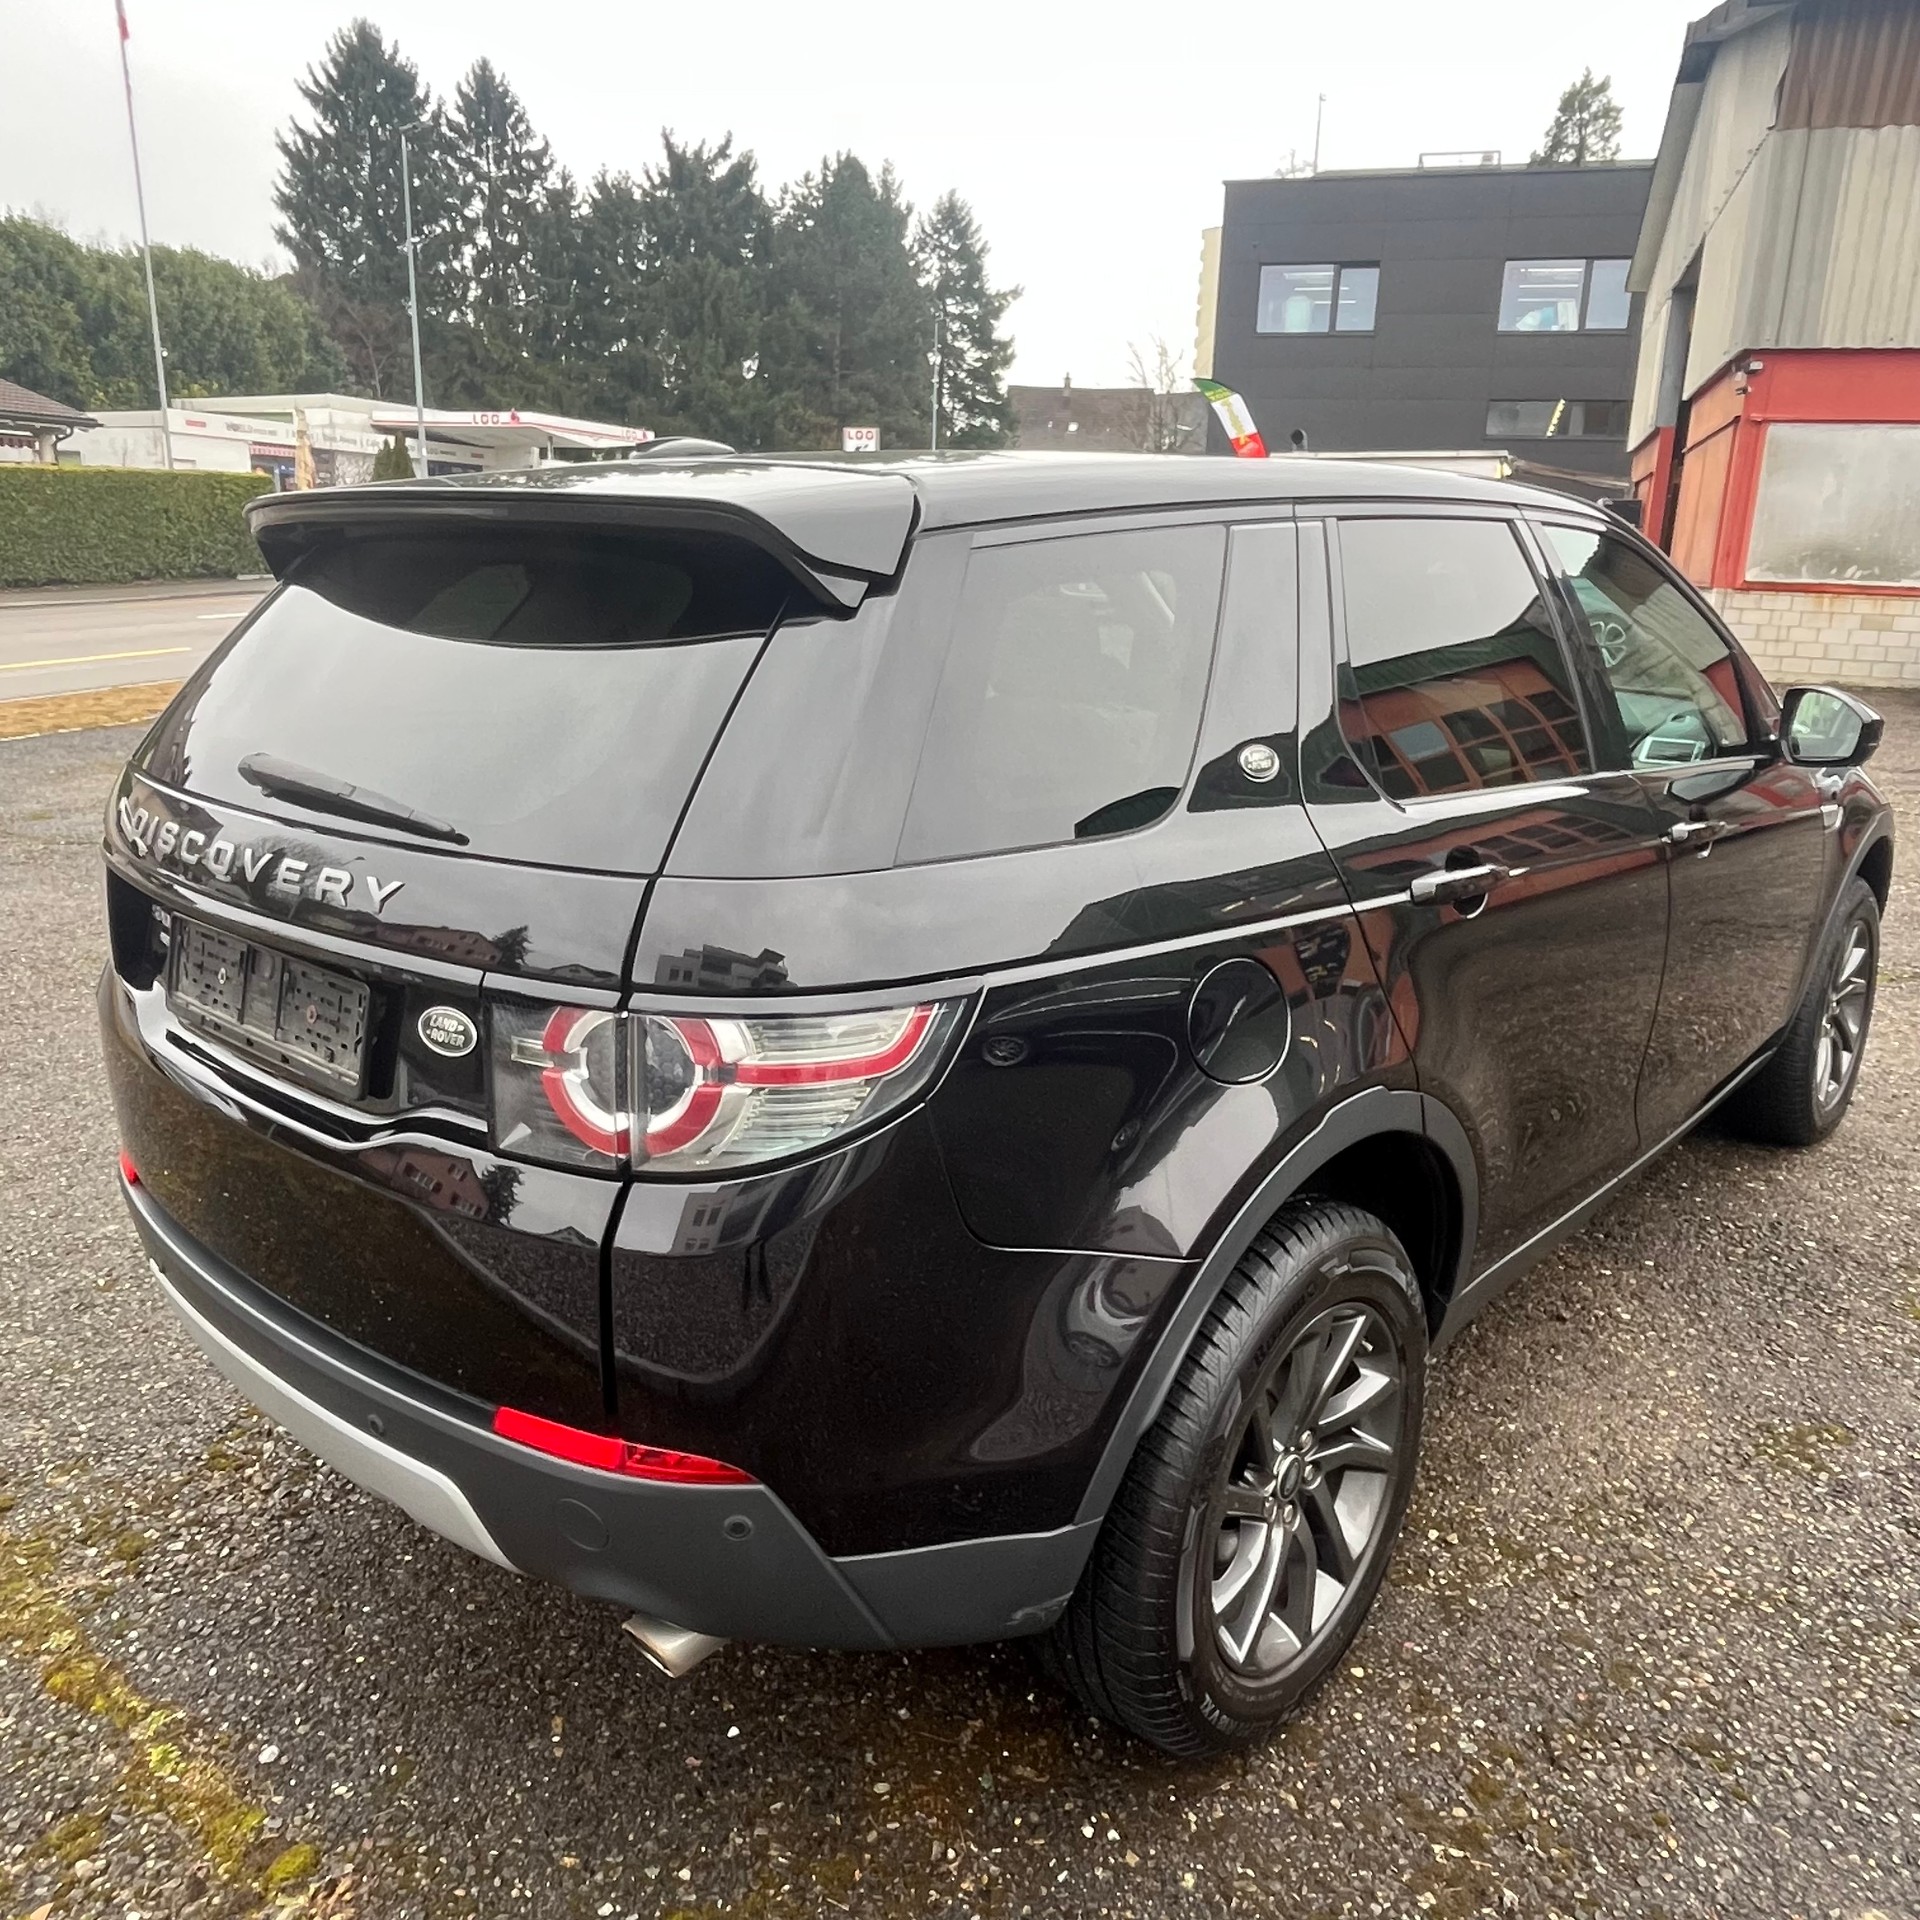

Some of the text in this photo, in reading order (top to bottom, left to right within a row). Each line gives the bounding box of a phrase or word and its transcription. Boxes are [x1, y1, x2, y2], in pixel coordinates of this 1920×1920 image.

[118, 796, 406, 915] DISCOVERY
[429, 1014, 459, 1032] LAND
[430, 1027, 466, 1048] ROVER
